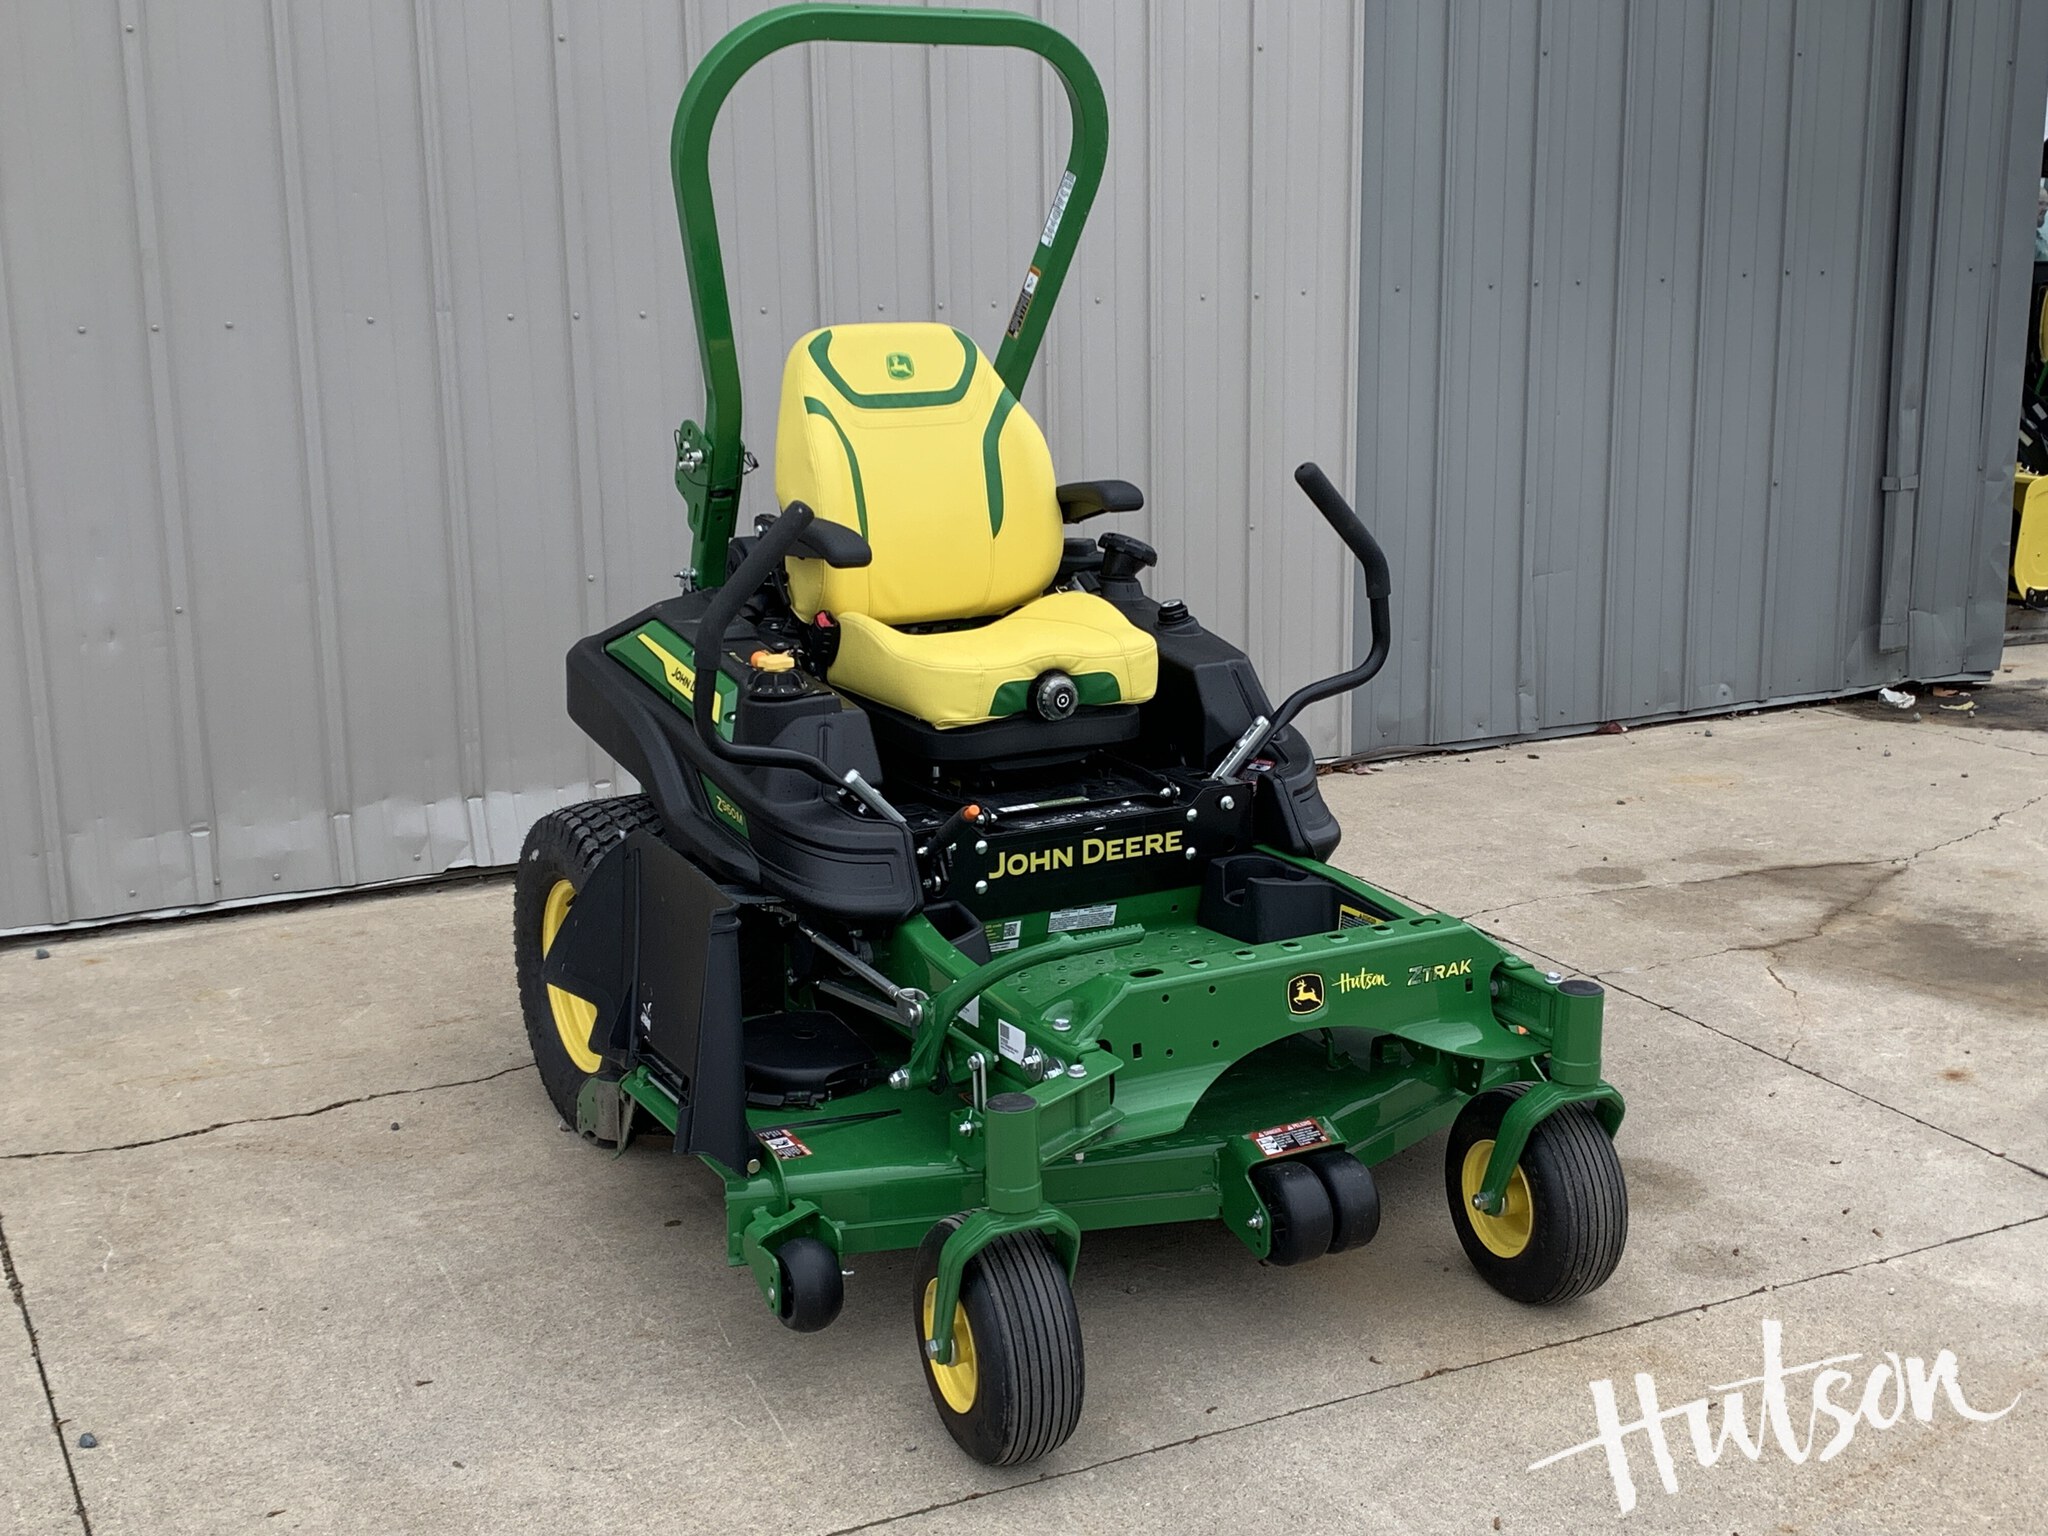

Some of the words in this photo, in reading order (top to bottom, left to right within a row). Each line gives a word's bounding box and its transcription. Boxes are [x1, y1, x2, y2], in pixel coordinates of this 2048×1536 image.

[671, 667, 691, 689] JOHN
[988, 845, 1073, 880] JOHN
[1082, 830, 1183, 865] DEERE
[1331, 967, 1391, 994] Hutson
[1407, 958, 1472, 986] ZTRAK
